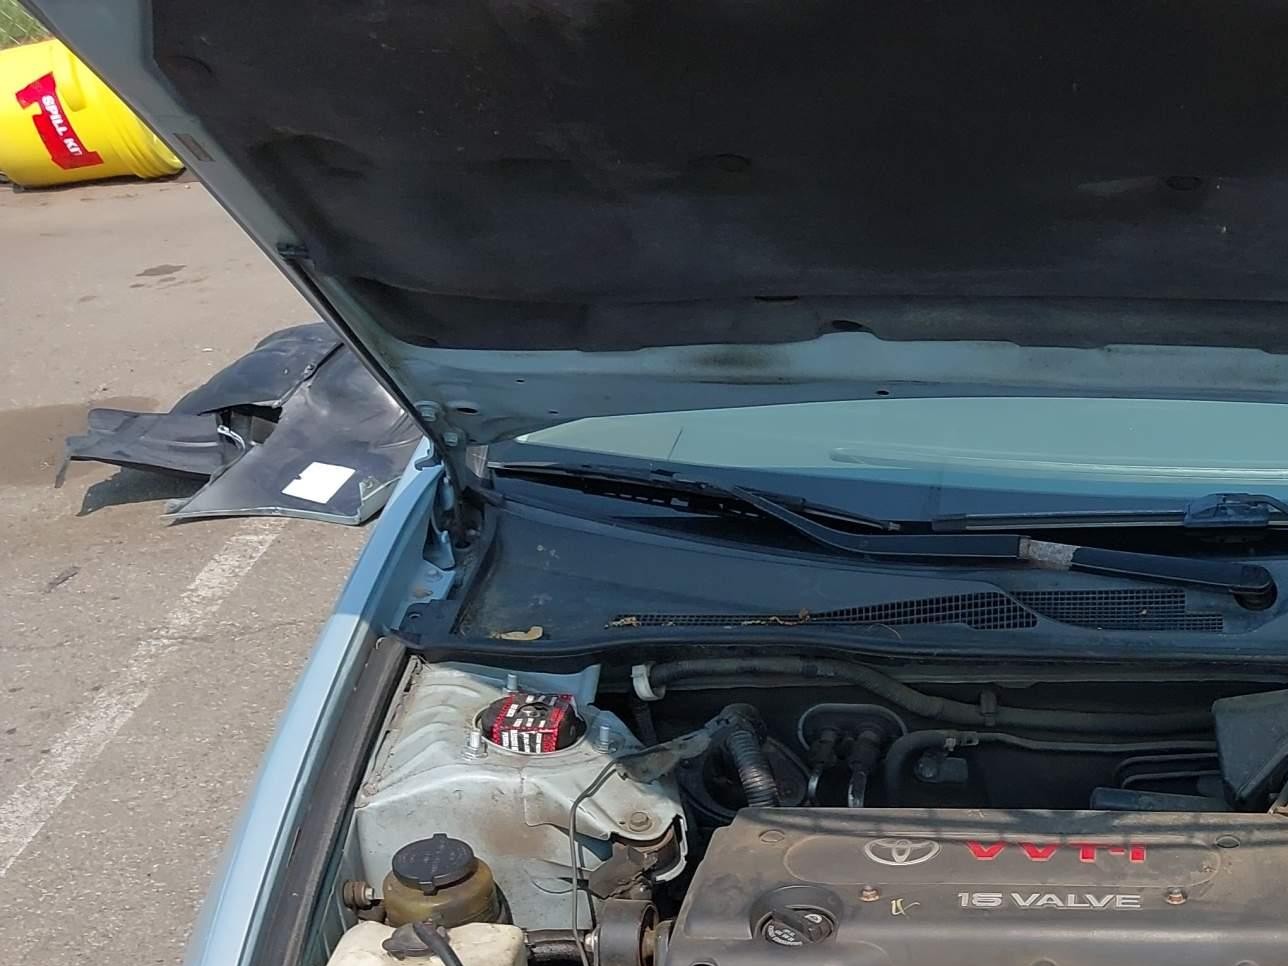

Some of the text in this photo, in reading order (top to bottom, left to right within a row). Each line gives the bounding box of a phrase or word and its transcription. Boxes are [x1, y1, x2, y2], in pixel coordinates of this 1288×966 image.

[41, 95, 68, 136] SPILL
[958, 892, 1143, 910] 16 VALVE
